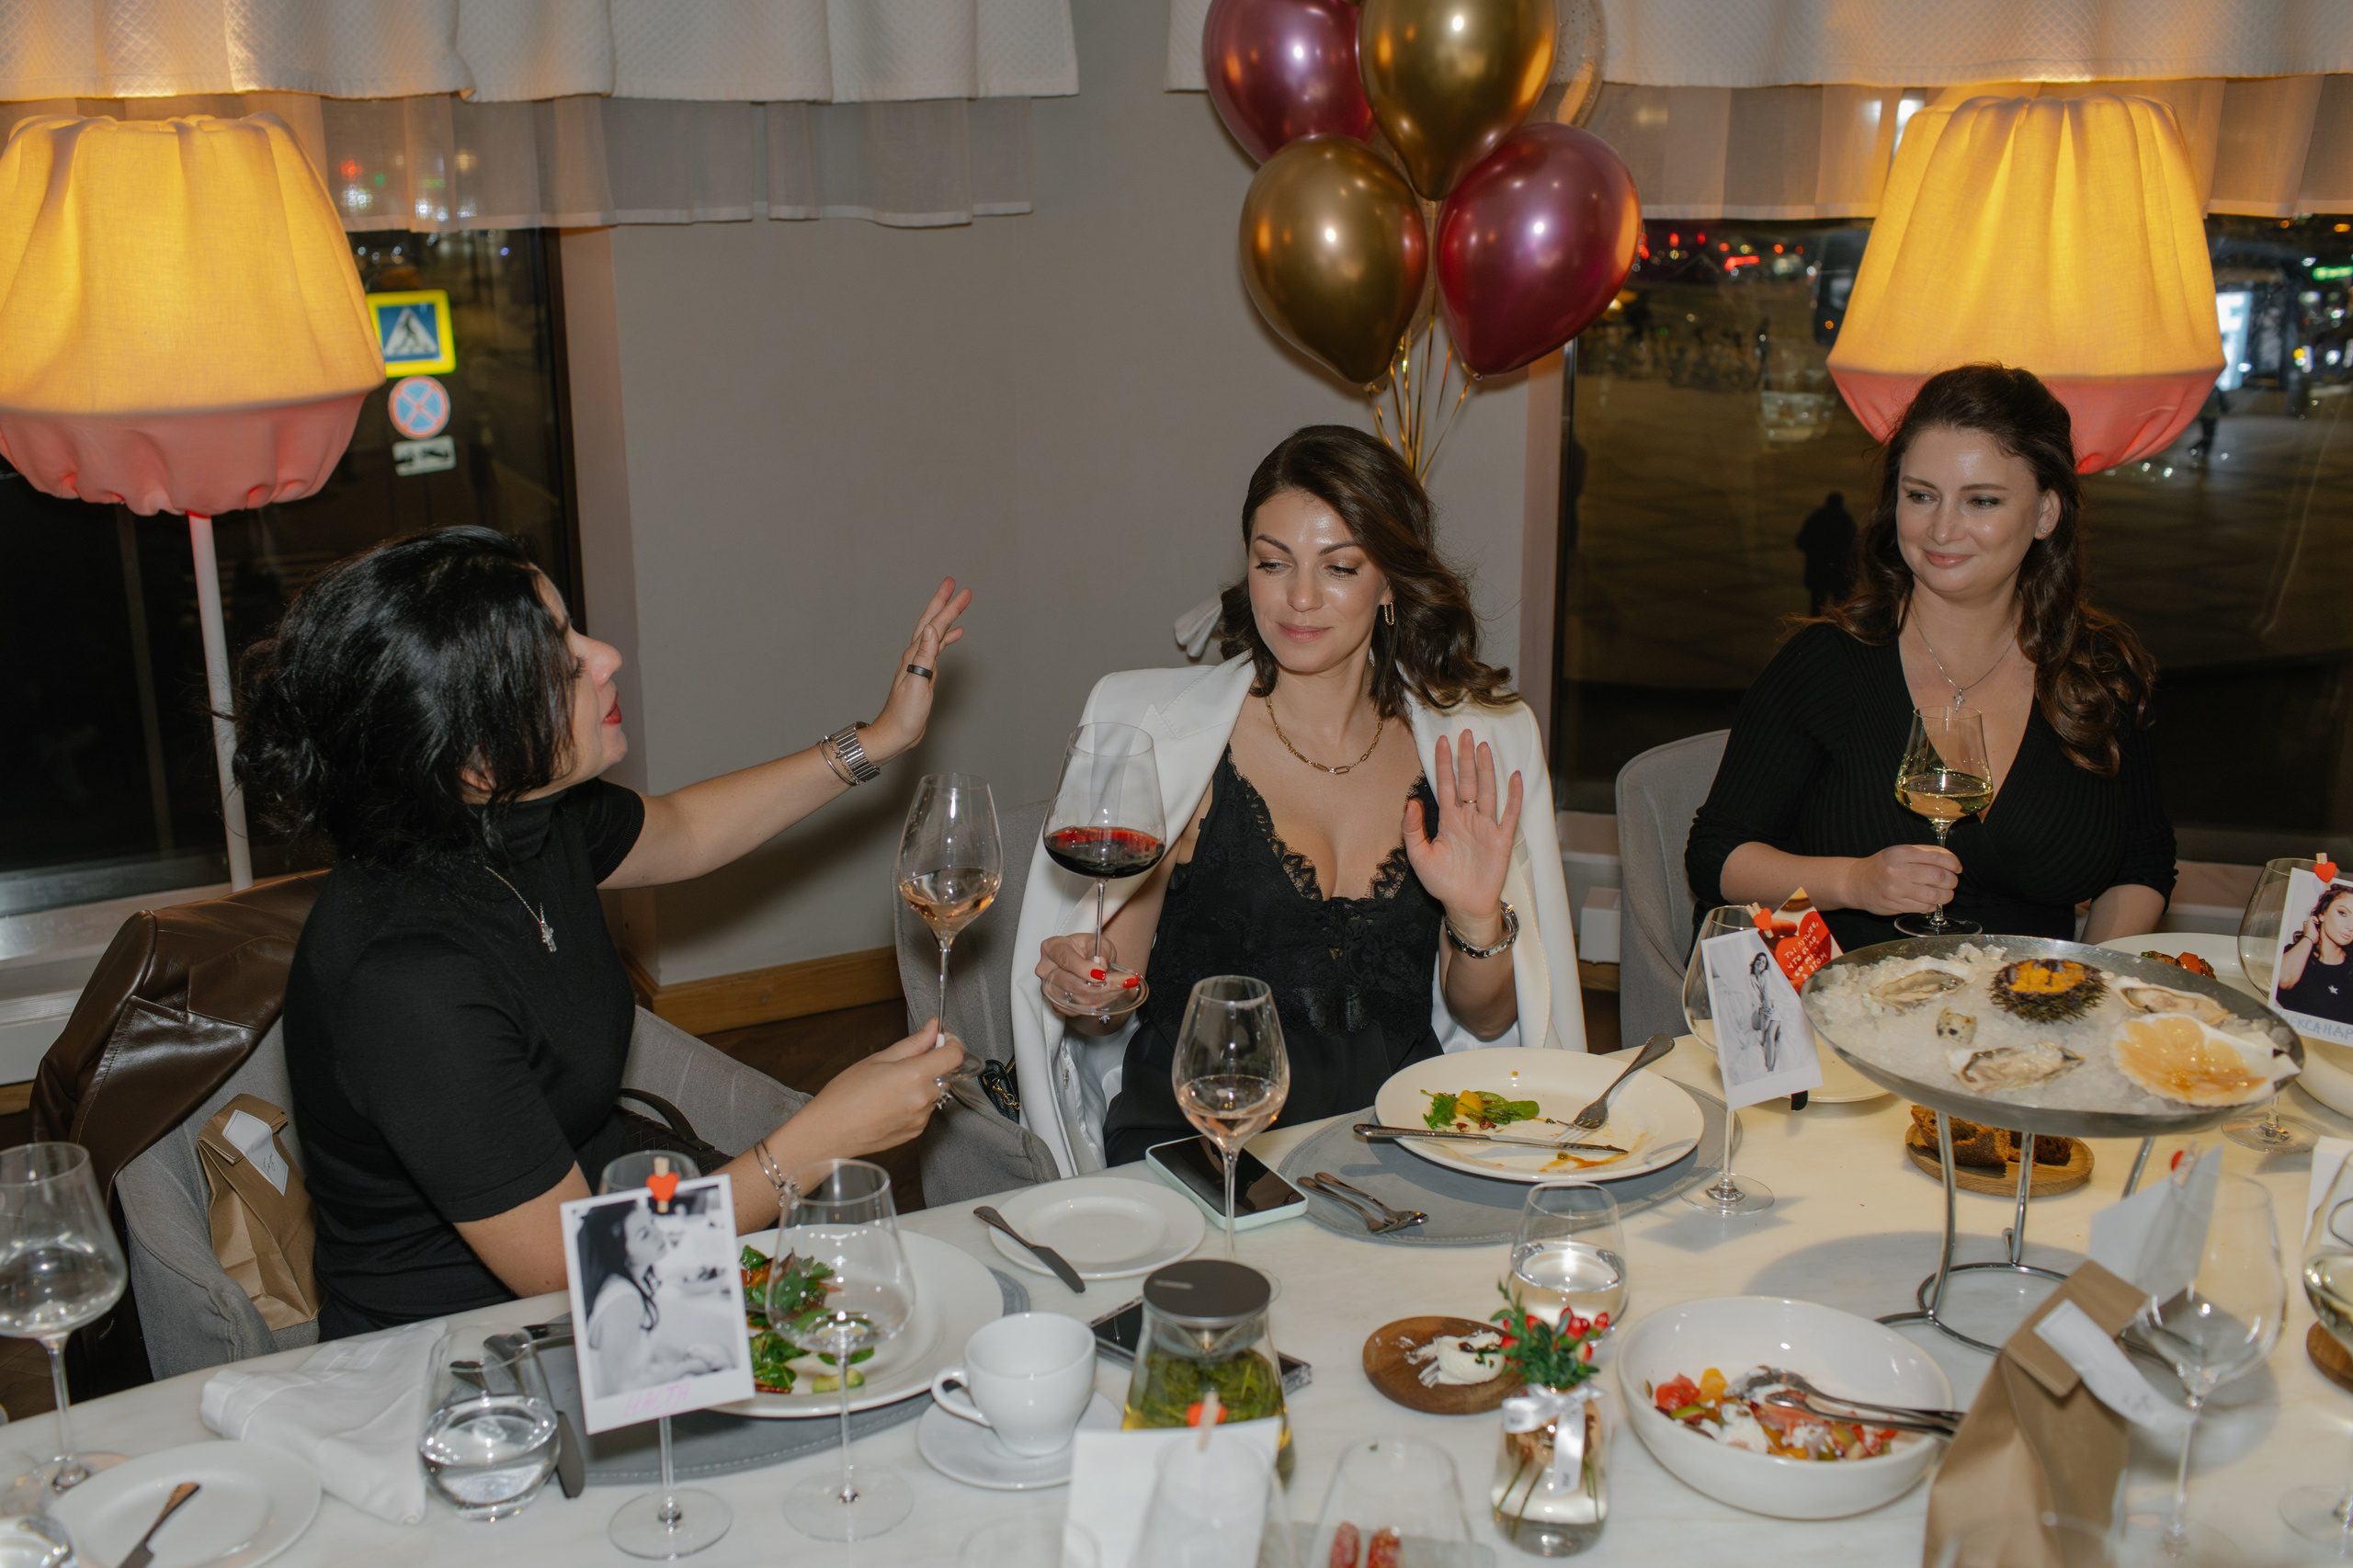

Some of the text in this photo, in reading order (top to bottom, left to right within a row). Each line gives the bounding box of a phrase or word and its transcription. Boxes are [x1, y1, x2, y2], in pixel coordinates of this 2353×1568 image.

[1784, 948, 1797, 959] ТЫ
[1787, 954, 1802, 969] ЧТО
[1809, 952, 1827, 971] ЭТОМ
[1794, 965, 1803, 977] СО
